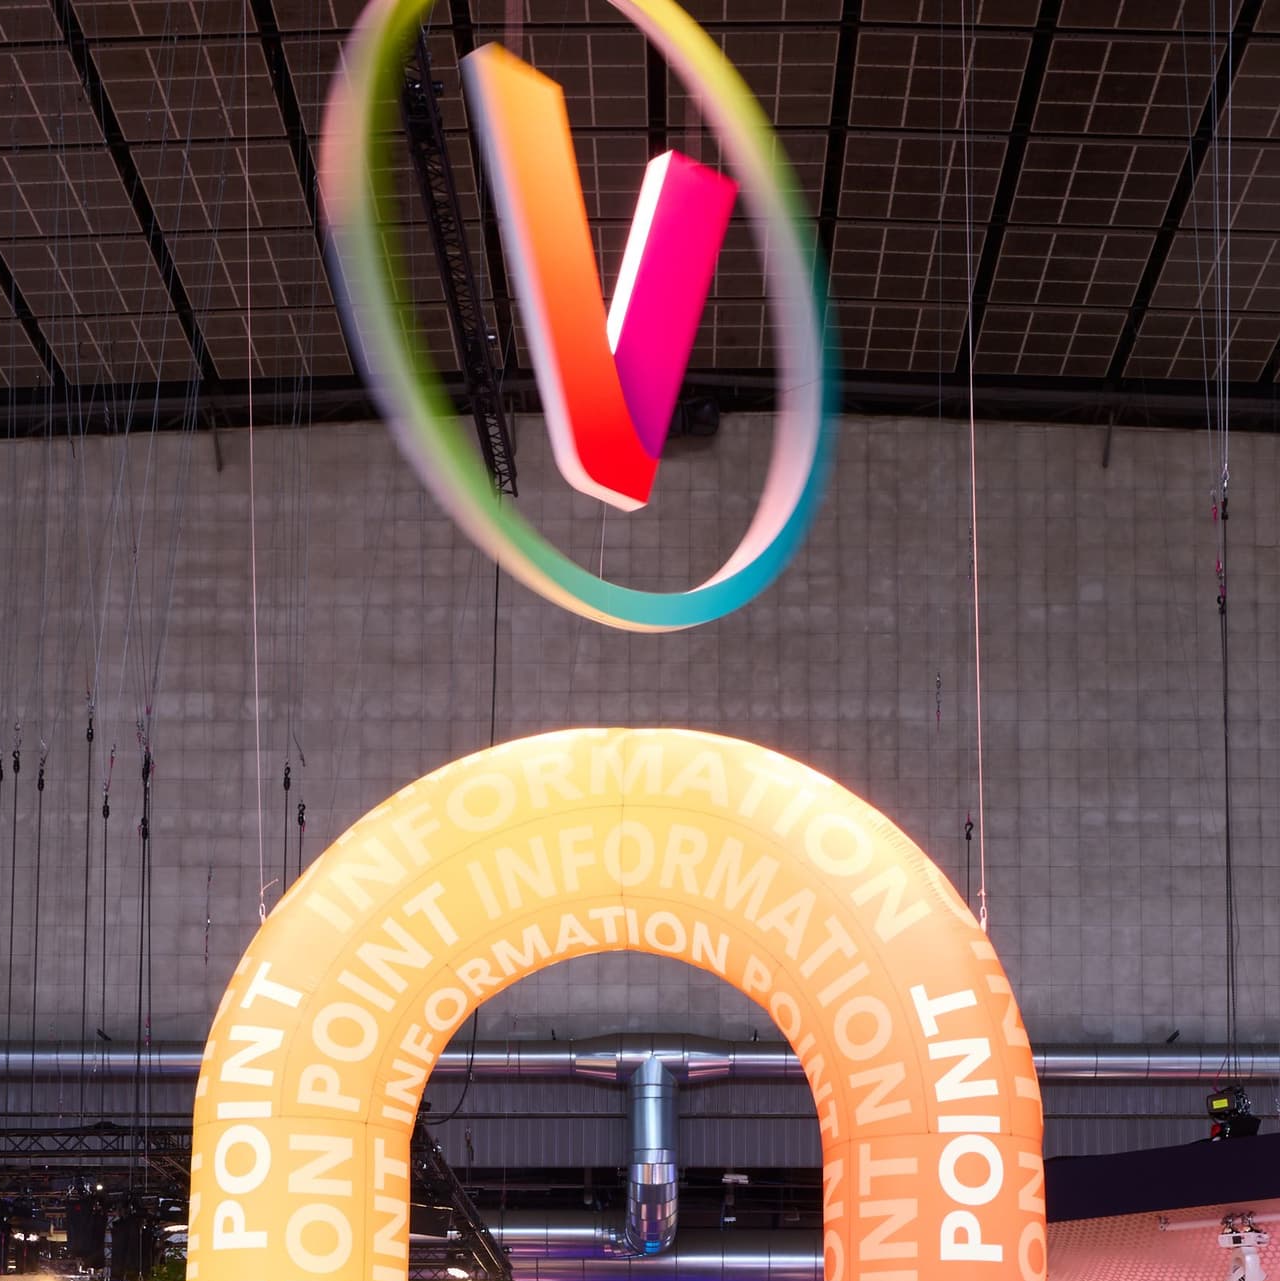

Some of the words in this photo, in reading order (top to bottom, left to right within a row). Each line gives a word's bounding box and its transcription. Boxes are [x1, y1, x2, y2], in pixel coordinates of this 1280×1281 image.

[298, 881, 460, 1113] POINT
[381, 906, 730, 1125] INFORMATION
[470, 821, 912, 1127] INFORMATION
[743, 955, 840, 1137] POINT
[213, 962, 303, 1252] POINT
[910, 984, 1004, 1263] POINT
